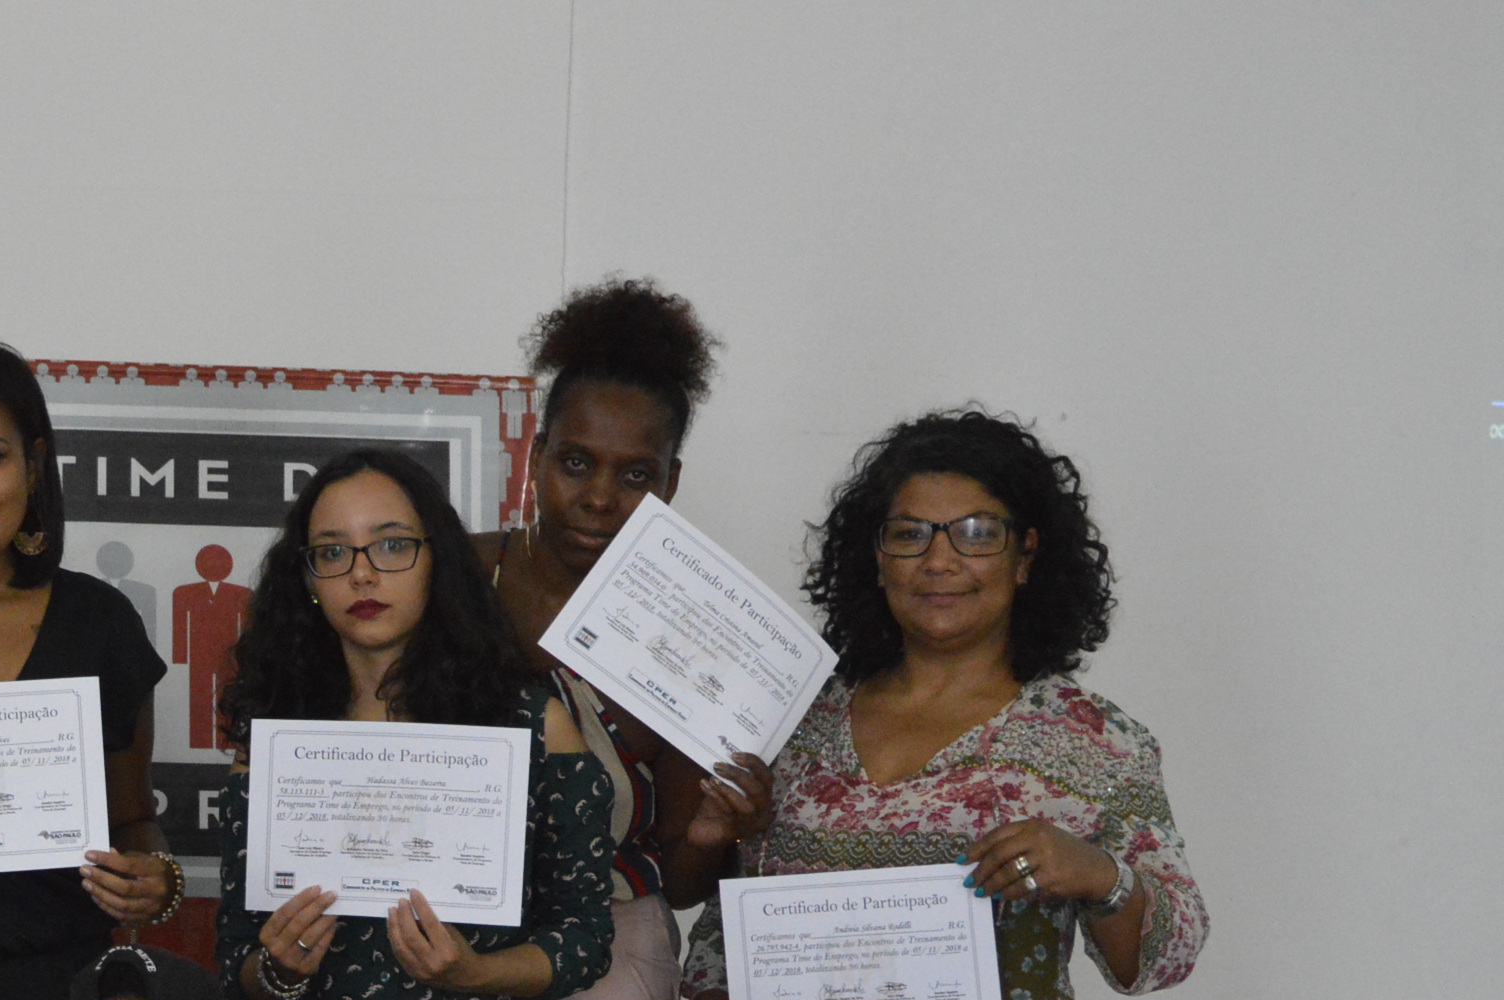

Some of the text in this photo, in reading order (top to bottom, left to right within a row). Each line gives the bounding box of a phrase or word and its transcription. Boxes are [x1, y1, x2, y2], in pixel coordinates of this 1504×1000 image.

[660, 535, 807, 661] Certificado de Participação
[644, 678, 677, 706] CPER
[57, 733, 75, 741] R.G.
[294, 744, 488, 770] Certificado de Participação
[277, 774, 325, 787] Certificamos
[328, 779, 342, 787] que
[484, 783, 502, 792] R.G.
[361, 879, 400, 887] CPER
[762, 891, 948, 917] Certificado de Participação
